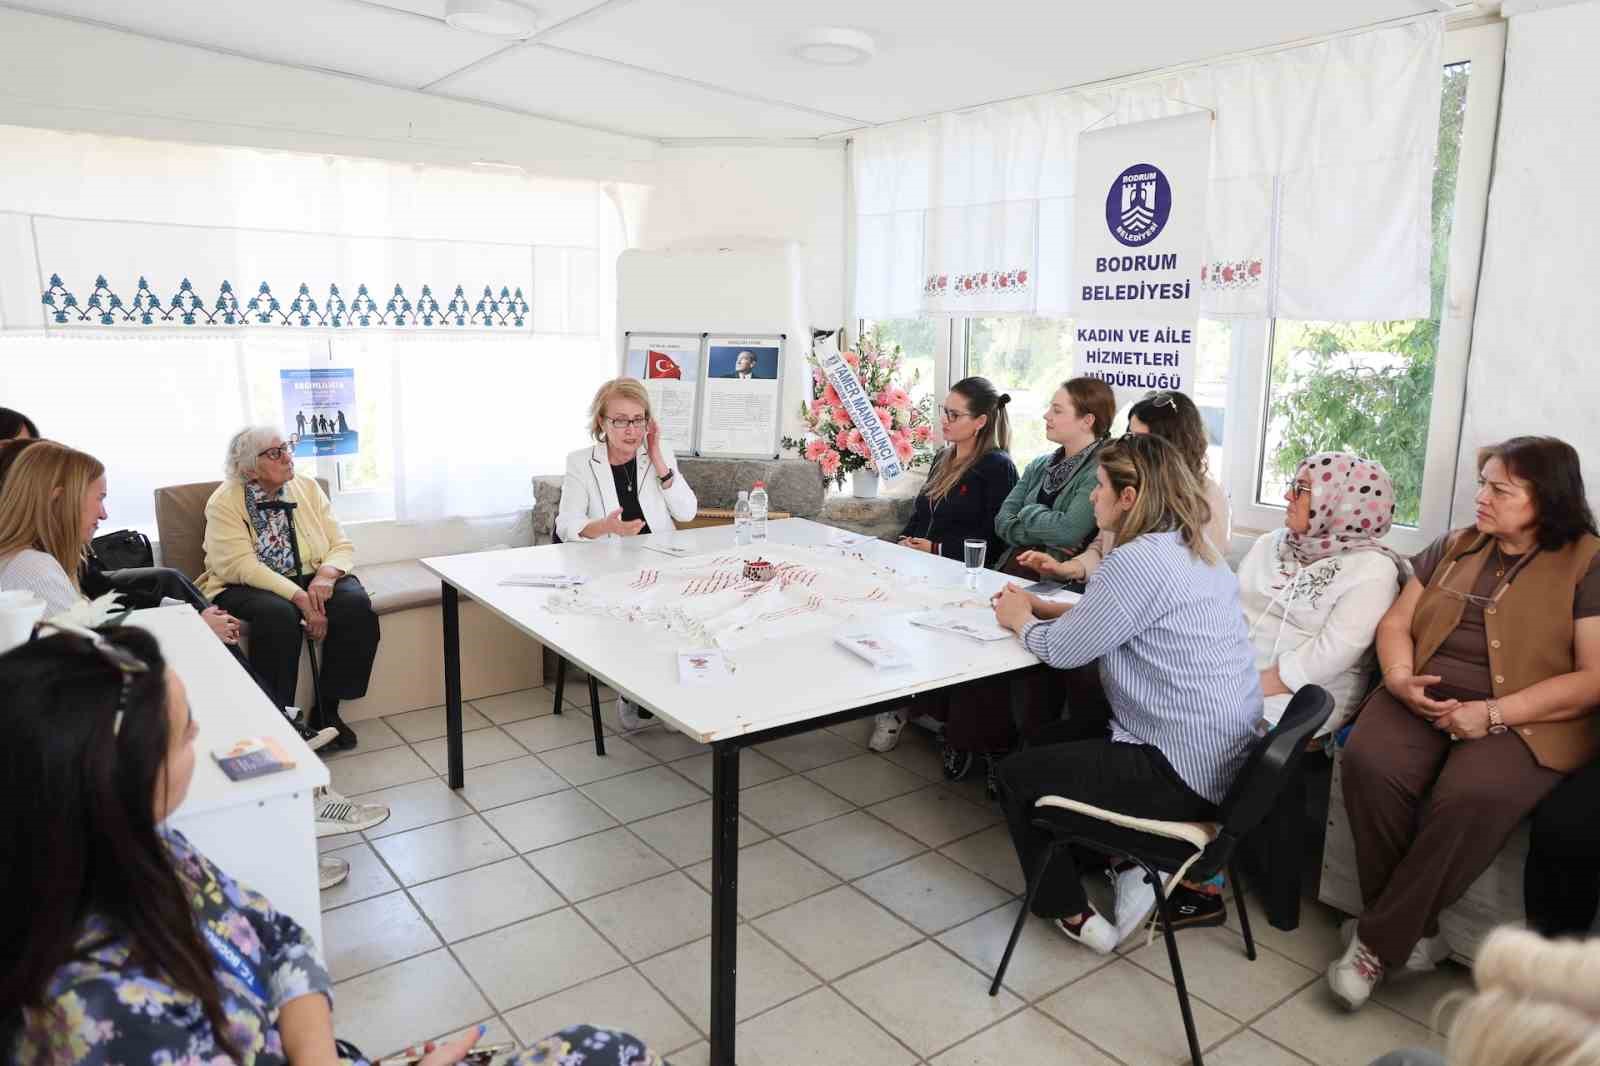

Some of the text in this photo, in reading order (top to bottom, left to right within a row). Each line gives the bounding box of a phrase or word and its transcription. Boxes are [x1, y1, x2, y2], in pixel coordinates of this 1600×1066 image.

[1123, 172, 1157, 184] BODRUM
[1096, 253, 1177, 273] BODRUM
[1082, 279, 1191, 301] BELEDİYESİ
[1077, 326, 1192, 344] KADIN VE AİLE
[1086, 348, 1179, 367] HİZMETLERİ
[835, 364, 860, 398] TAMER
